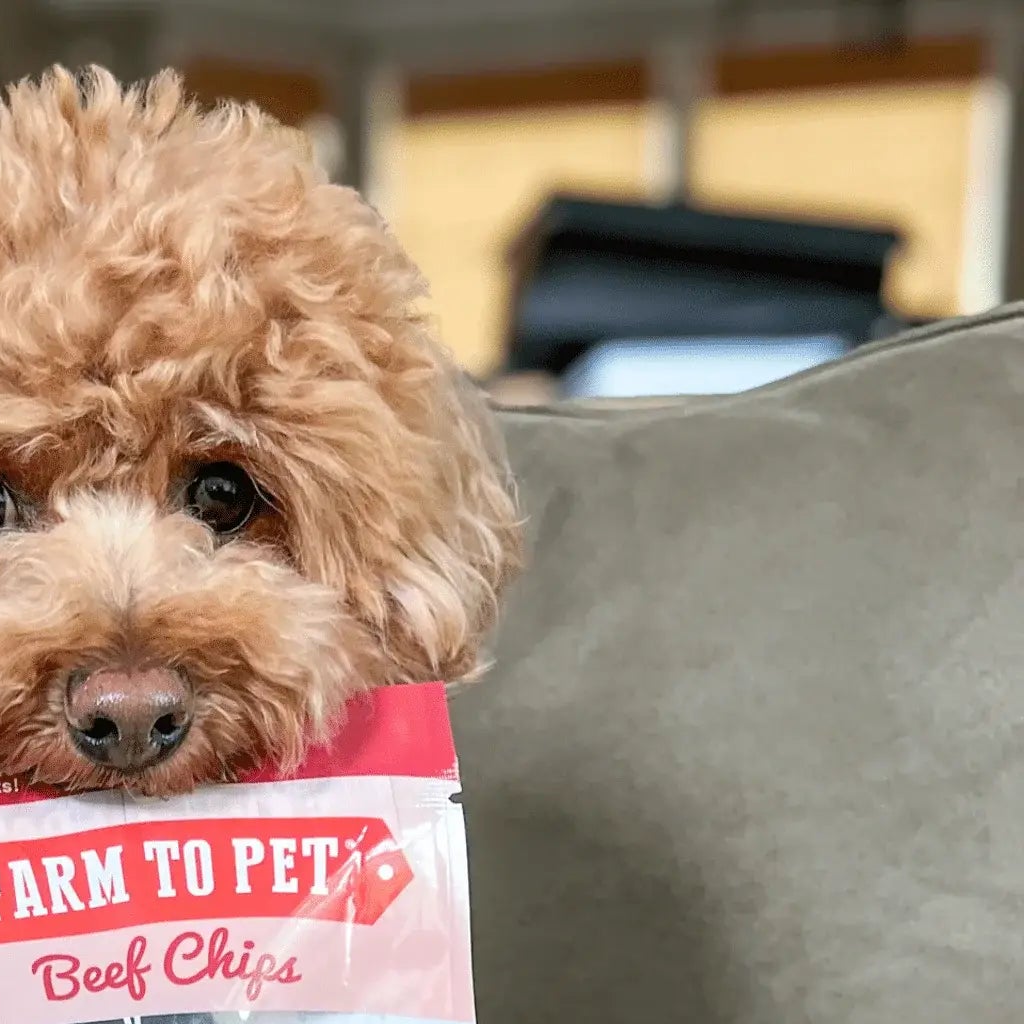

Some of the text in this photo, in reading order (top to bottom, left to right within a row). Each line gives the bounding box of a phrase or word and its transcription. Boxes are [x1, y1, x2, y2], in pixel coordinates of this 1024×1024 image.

[144, 838, 215, 898] TO
[32, 927, 302, 1001] Beef Chips
